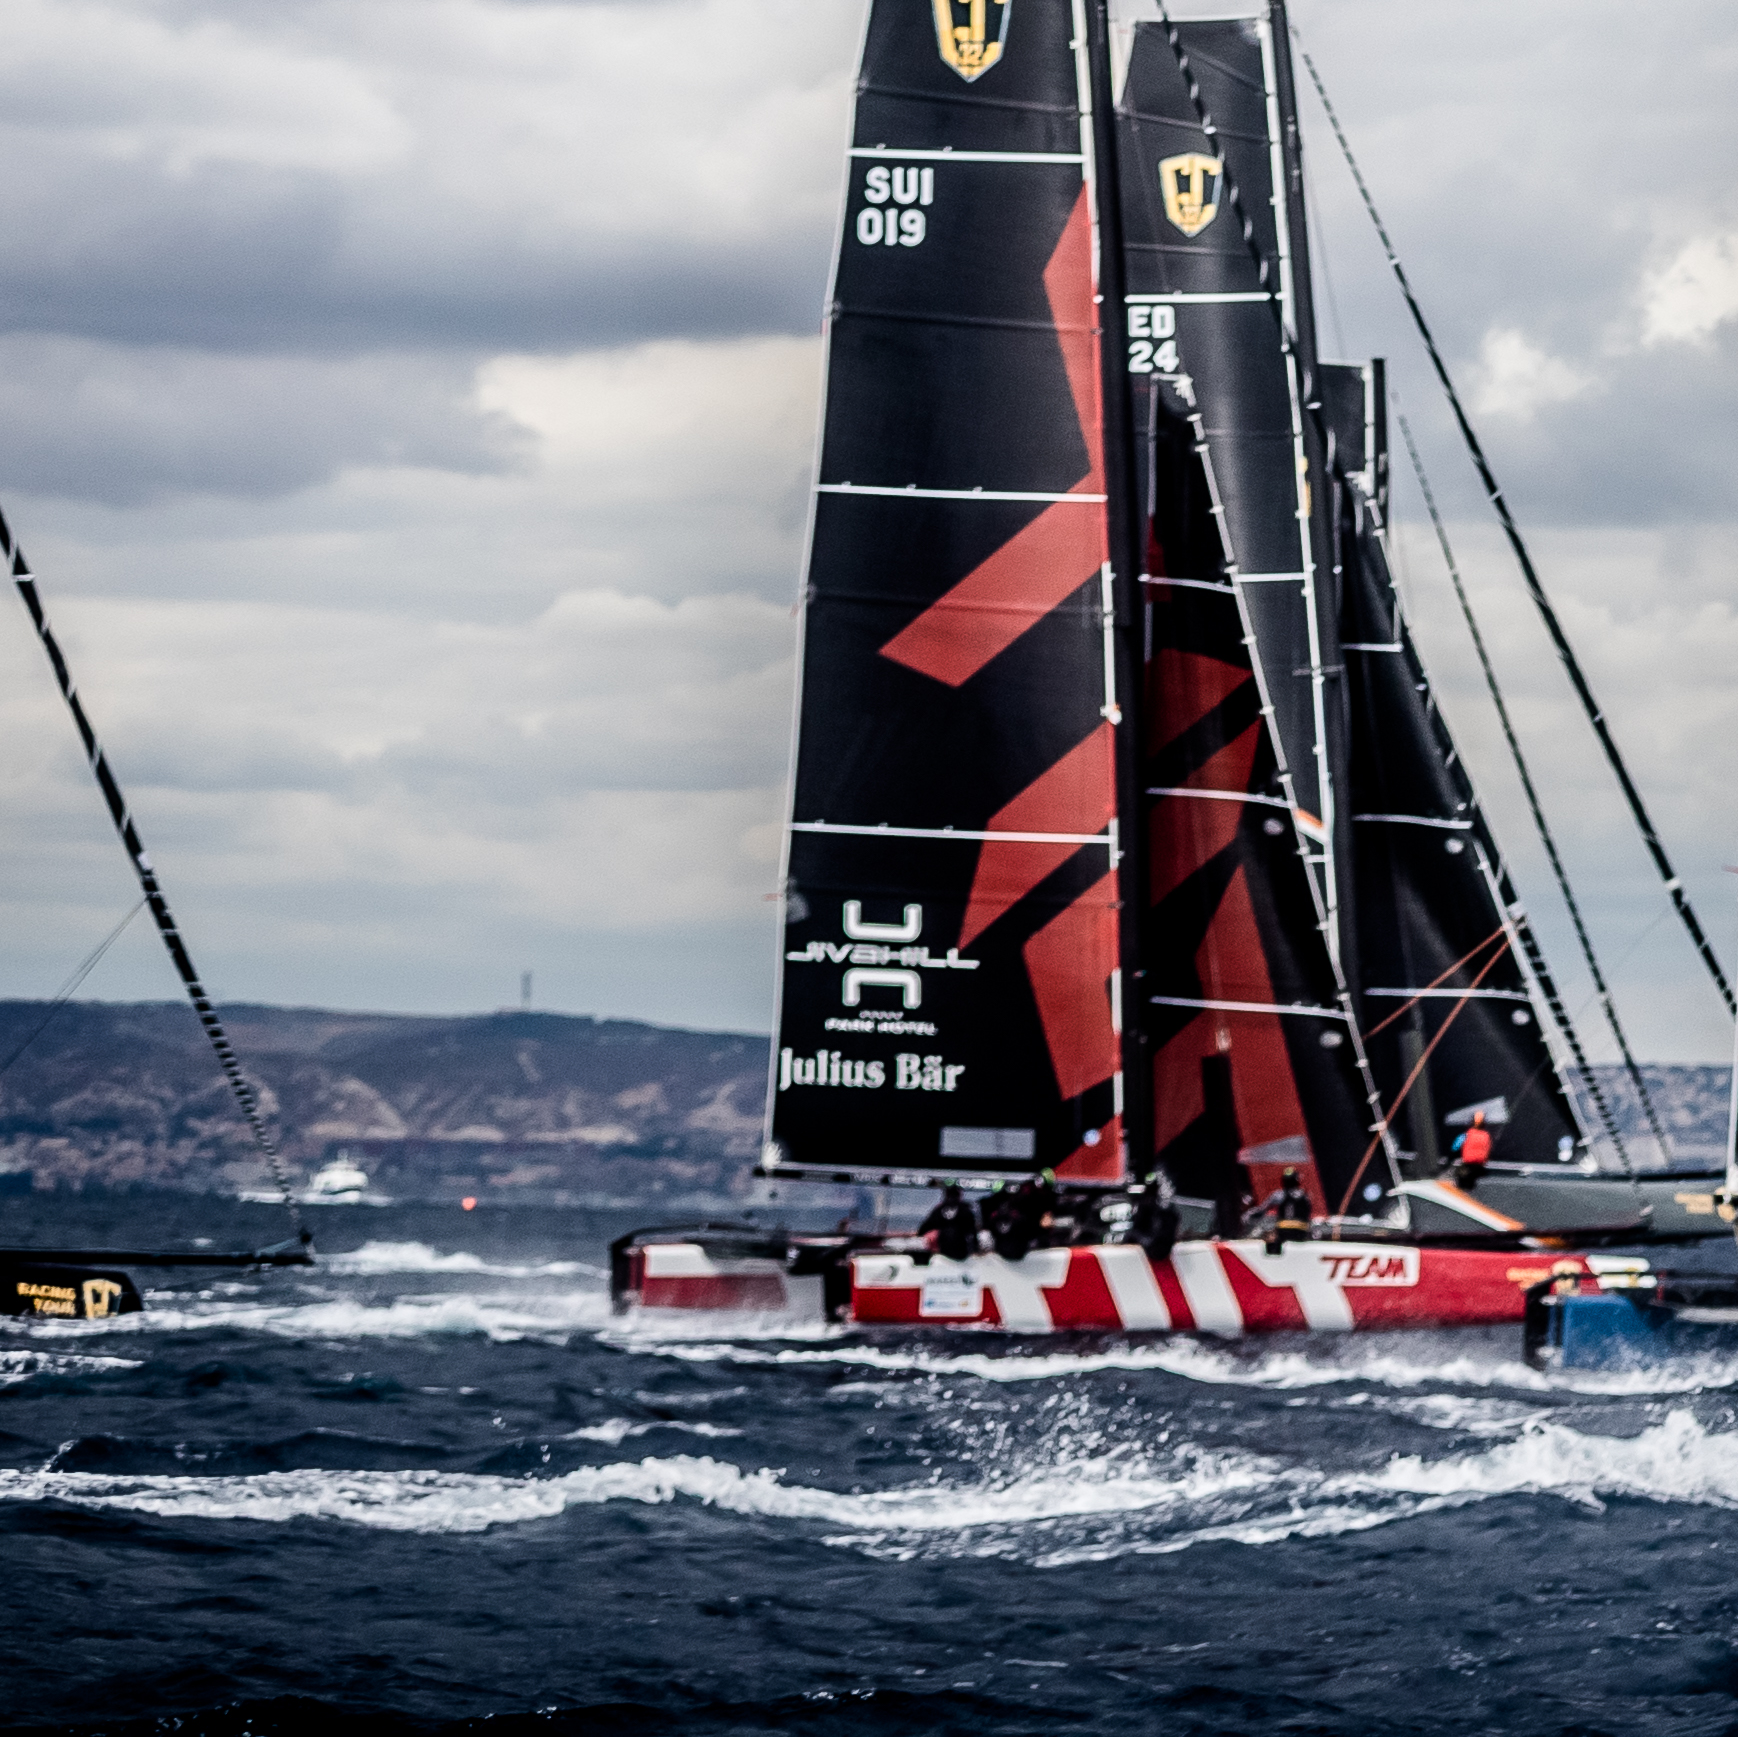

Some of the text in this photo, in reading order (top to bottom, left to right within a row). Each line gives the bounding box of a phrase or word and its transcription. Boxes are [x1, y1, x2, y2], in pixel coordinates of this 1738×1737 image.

[864, 165, 934, 206] SUI
[856, 207, 926, 248] 019
[1127, 305, 1176, 339] ED
[1127, 340, 1180, 374] 24
[778, 1046, 966, 1092] Julius Bär
